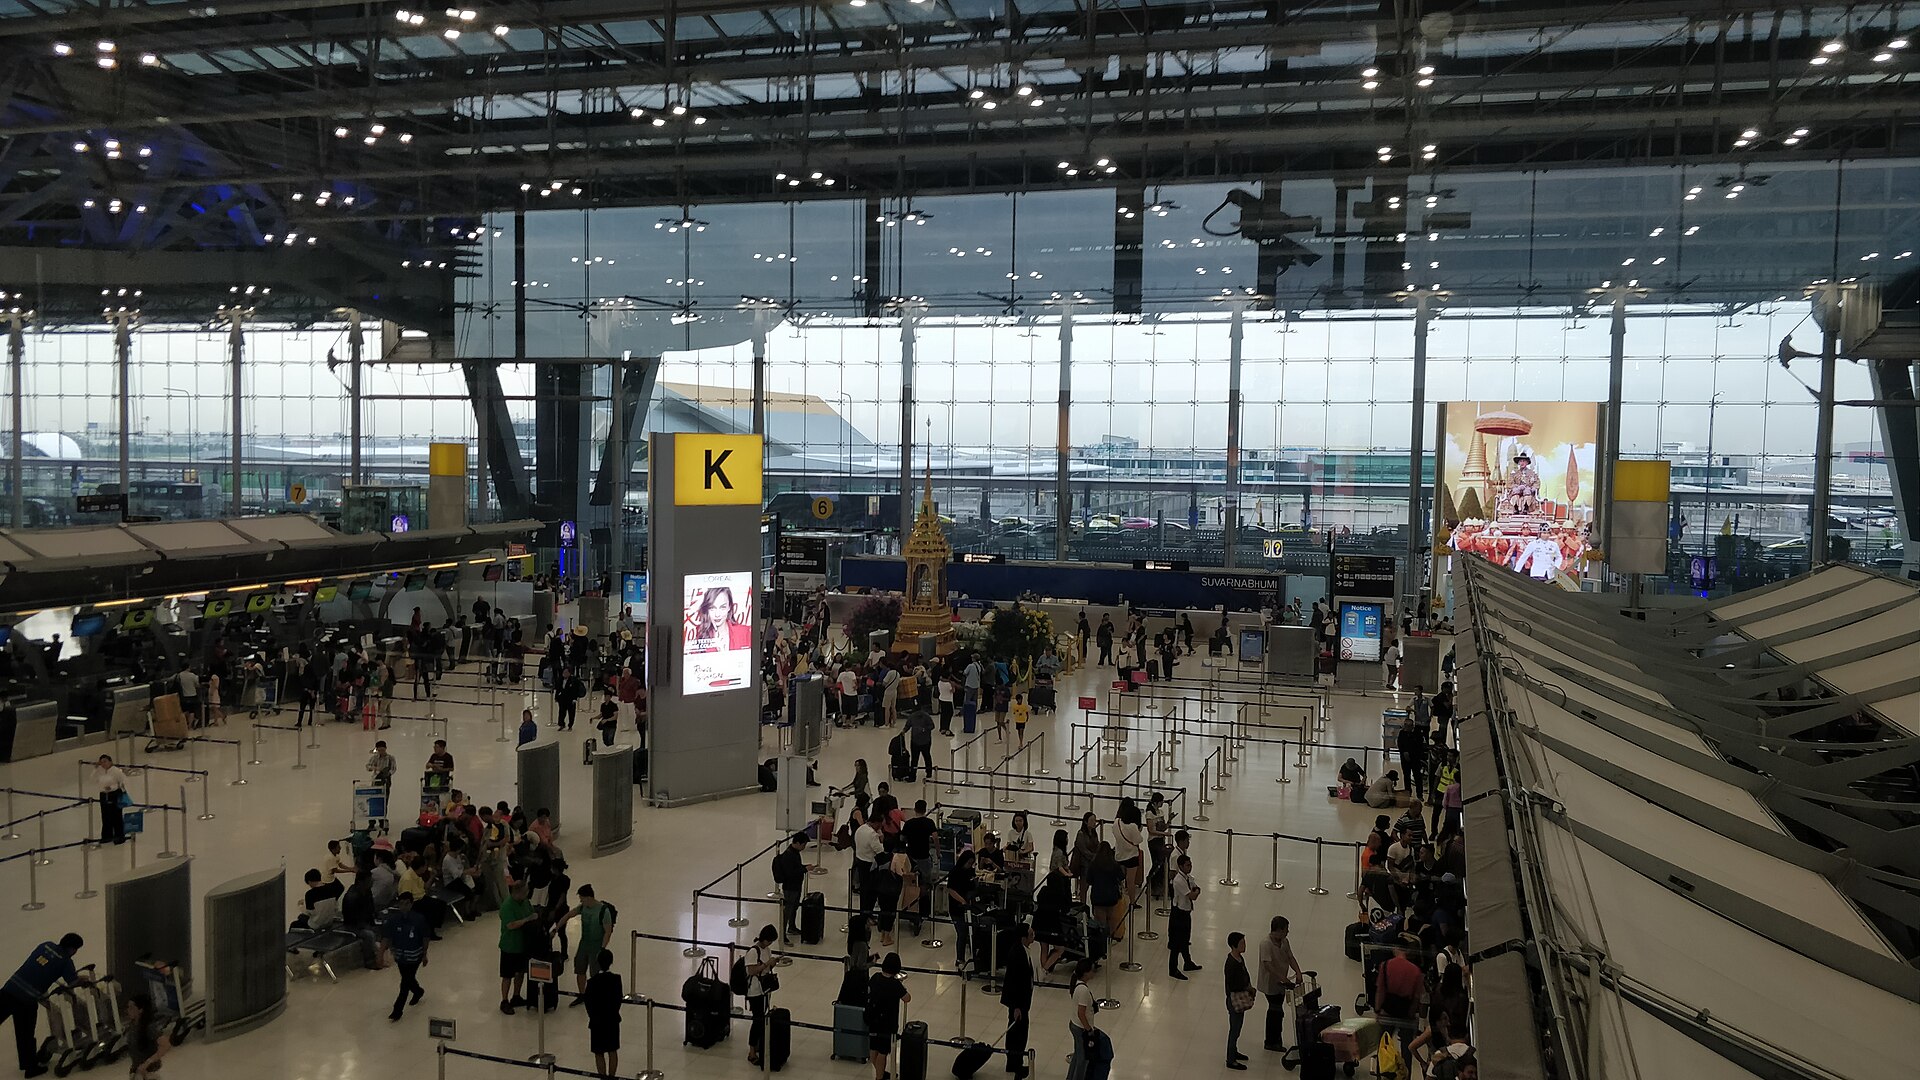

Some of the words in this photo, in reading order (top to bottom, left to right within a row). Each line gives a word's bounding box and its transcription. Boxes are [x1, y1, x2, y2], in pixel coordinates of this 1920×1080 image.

[704, 449, 734, 490] K
[294, 487, 302, 500] 7
[818, 500, 828, 515] 6
[1201, 577, 1278, 589] SUVARNABHUMI
